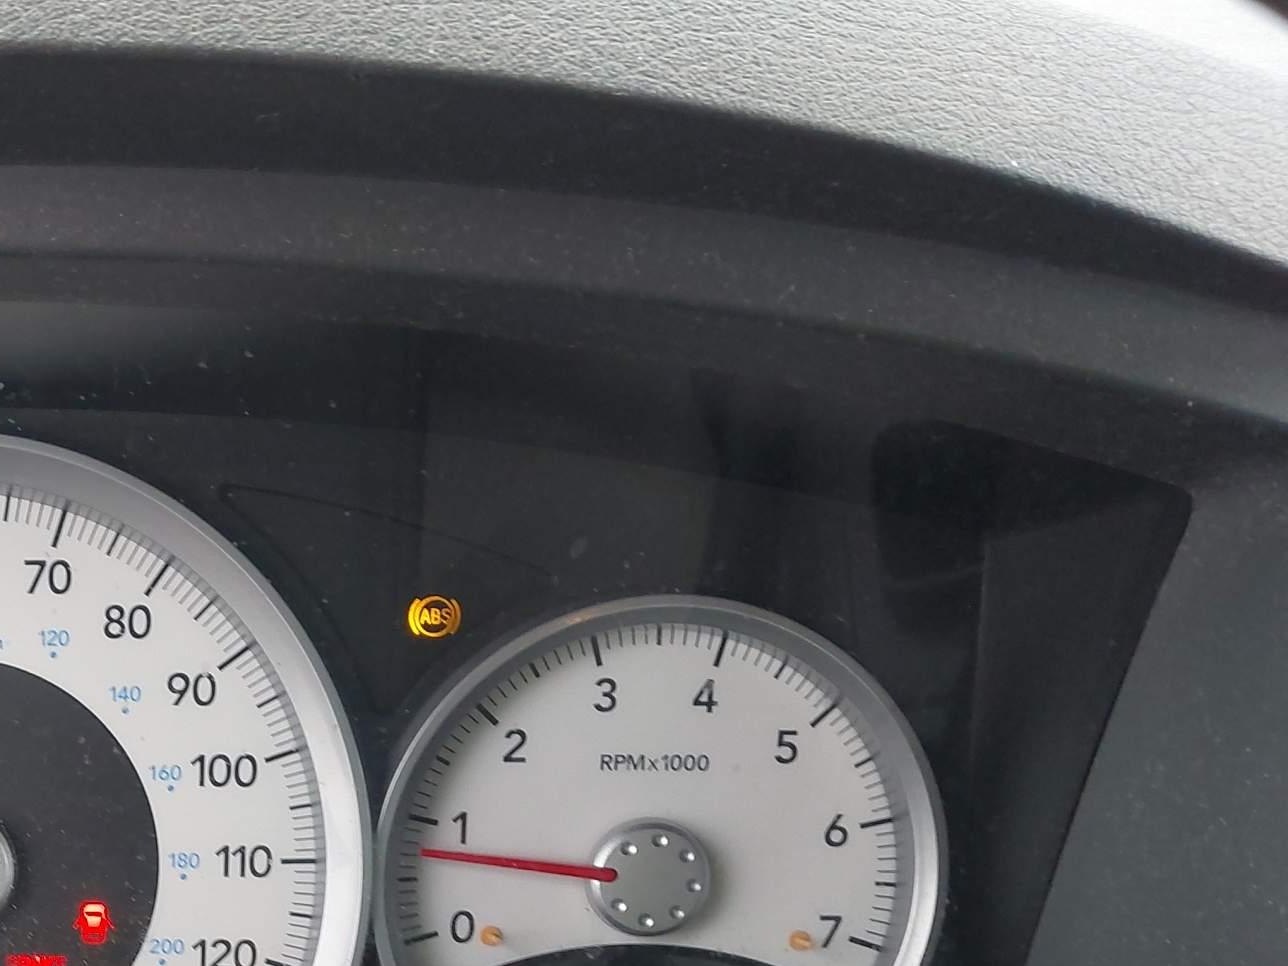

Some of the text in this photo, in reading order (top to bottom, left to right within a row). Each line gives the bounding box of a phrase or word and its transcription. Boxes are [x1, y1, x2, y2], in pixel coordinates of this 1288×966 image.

[25, 560, 71, 594] 70
[104, 605, 151, 639] 80
[420, 607, 451, 625] ABS
[41, 630, 69, 646] 120
[112, 686, 141, 702] 140
[168, 673, 215, 706] 90
[594, 678, 616, 712] 3
[693, 679, 717, 712] 4
[504, 729, 526, 762] 2
[775, 731, 797, 764] 5
[152, 765, 181, 780] 160
[191, 755, 257, 787] 100
[453, 812, 467, 844] 1
[825, 814, 848, 847] 6
[171, 853, 199, 868] 180
[216, 846, 272, 877] 110
[451, 911, 474, 943] 0
[820, 916, 842, 948] 7
[150, 939, 184, 954] 200
